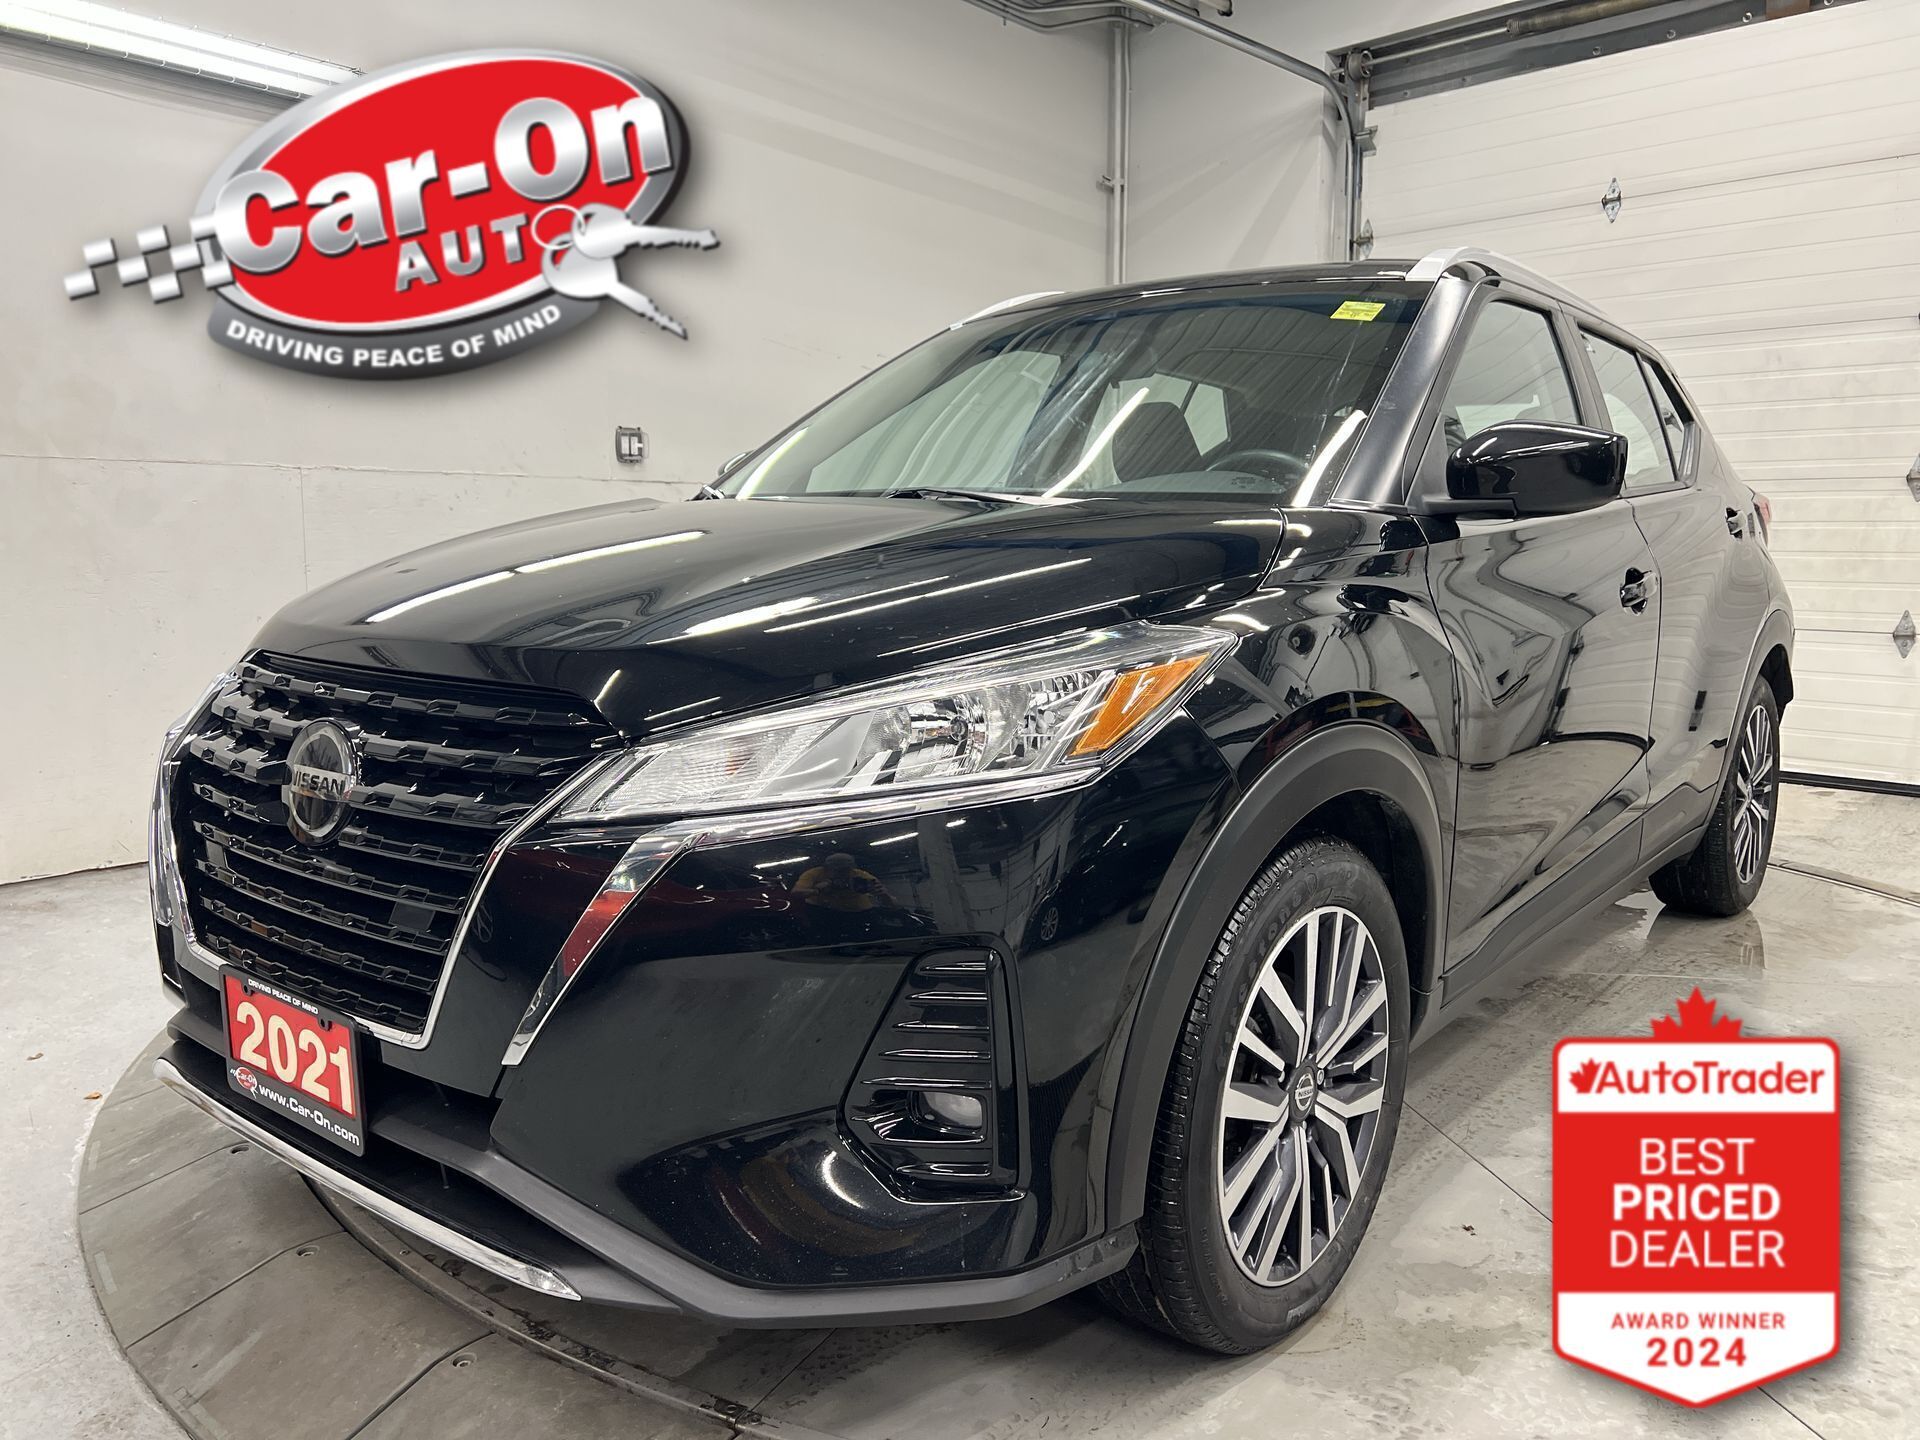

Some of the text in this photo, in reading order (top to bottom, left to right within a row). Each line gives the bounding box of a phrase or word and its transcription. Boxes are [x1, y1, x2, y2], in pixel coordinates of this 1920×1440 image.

[247, 978, 319, 1015] DRIVING PEACE OF MIND
[236, 1001, 353, 1115] 2021
[259, 1084, 360, 1147] www.Car-On.com
